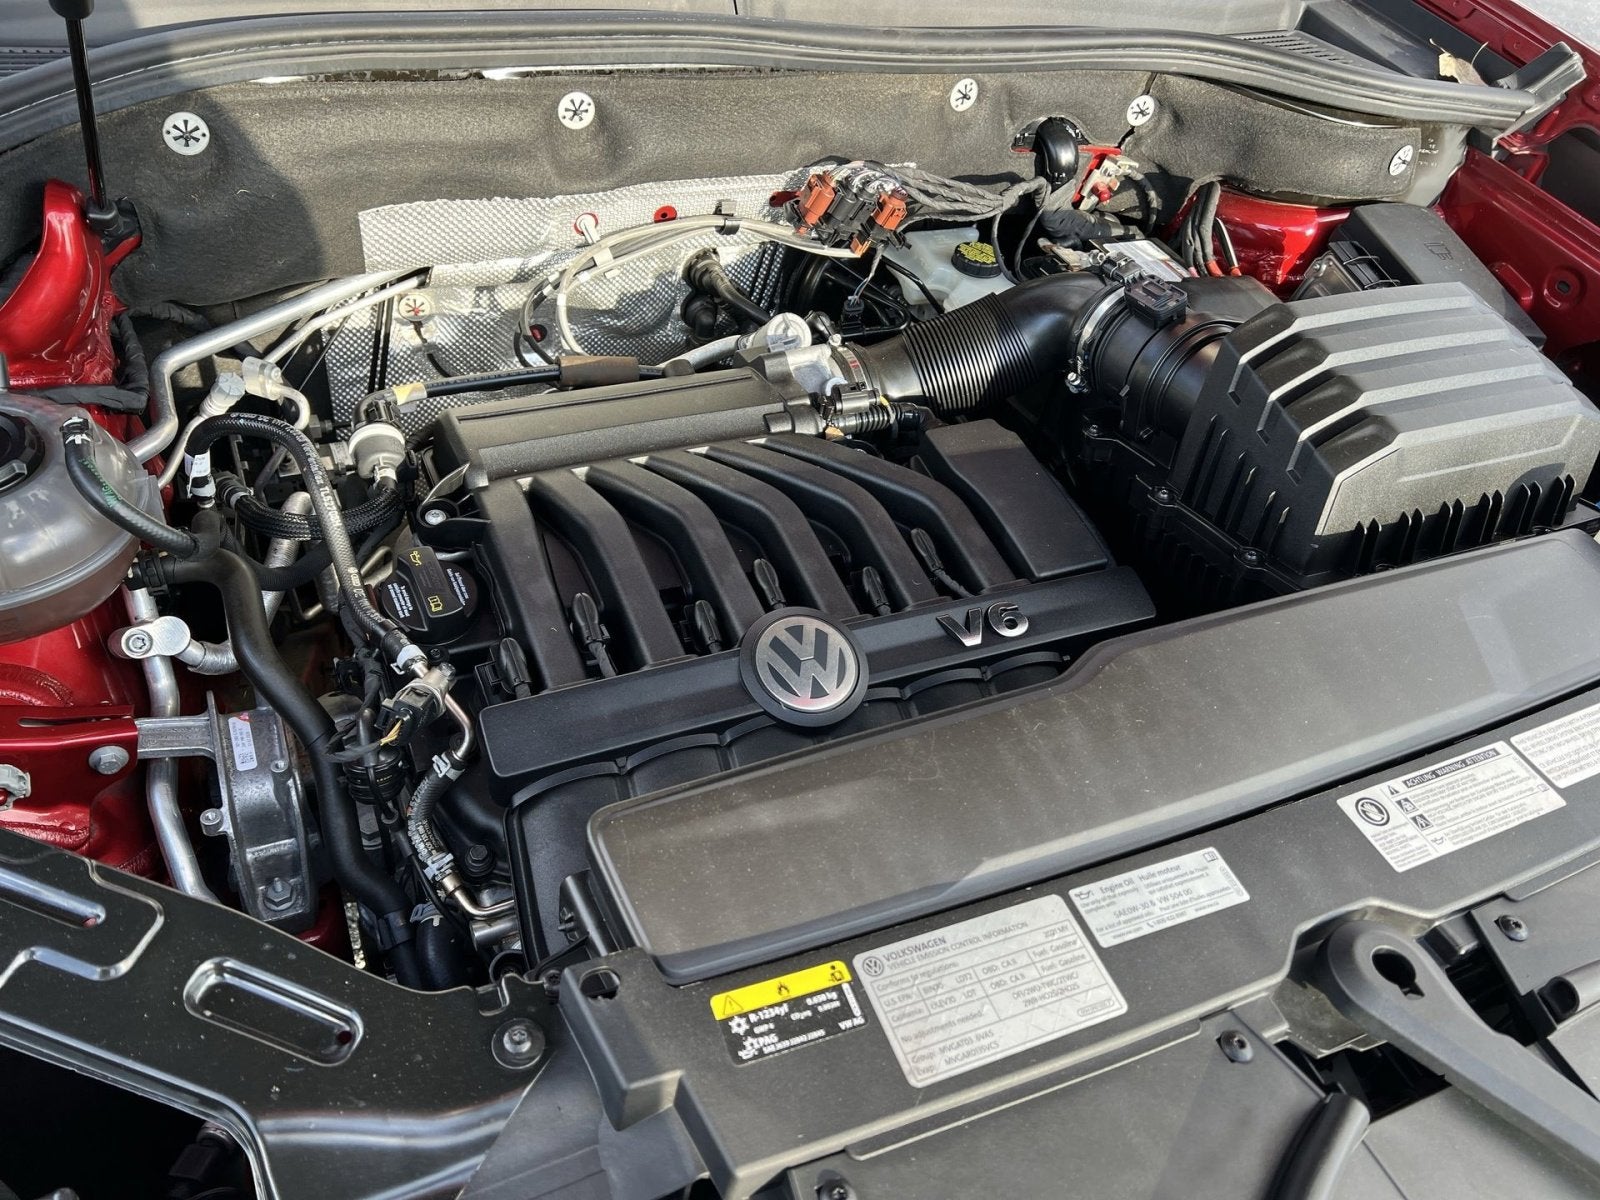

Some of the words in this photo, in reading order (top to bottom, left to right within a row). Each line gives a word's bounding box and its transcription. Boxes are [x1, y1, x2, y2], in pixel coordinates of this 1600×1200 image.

[935, 601, 1030, 648] V6
[1407, 773, 1435, 786] ACHTUNG
[1436, 762, 1465, 775] WARNING
[1466, 751, 1496, 764] ATTENTION
[1139, 873, 1156, 881] Huile
[1158, 866, 1181, 876] moteur
[1100, 883, 1123, 894] Engine
[1124, 878, 1134, 886] Oil
[884, 938, 946, 961] VOLKSWAGEN
[888, 957, 916, 970] VEHICLE
[917, 948, 950, 961] EMISSION
[951, 937, 981, 950] CONTROL
[983, 923, 1028, 939] INFORMATION
[748, 1002, 789, 1023] R-1234yf
[758, 1033, 779, 1047] PAG
